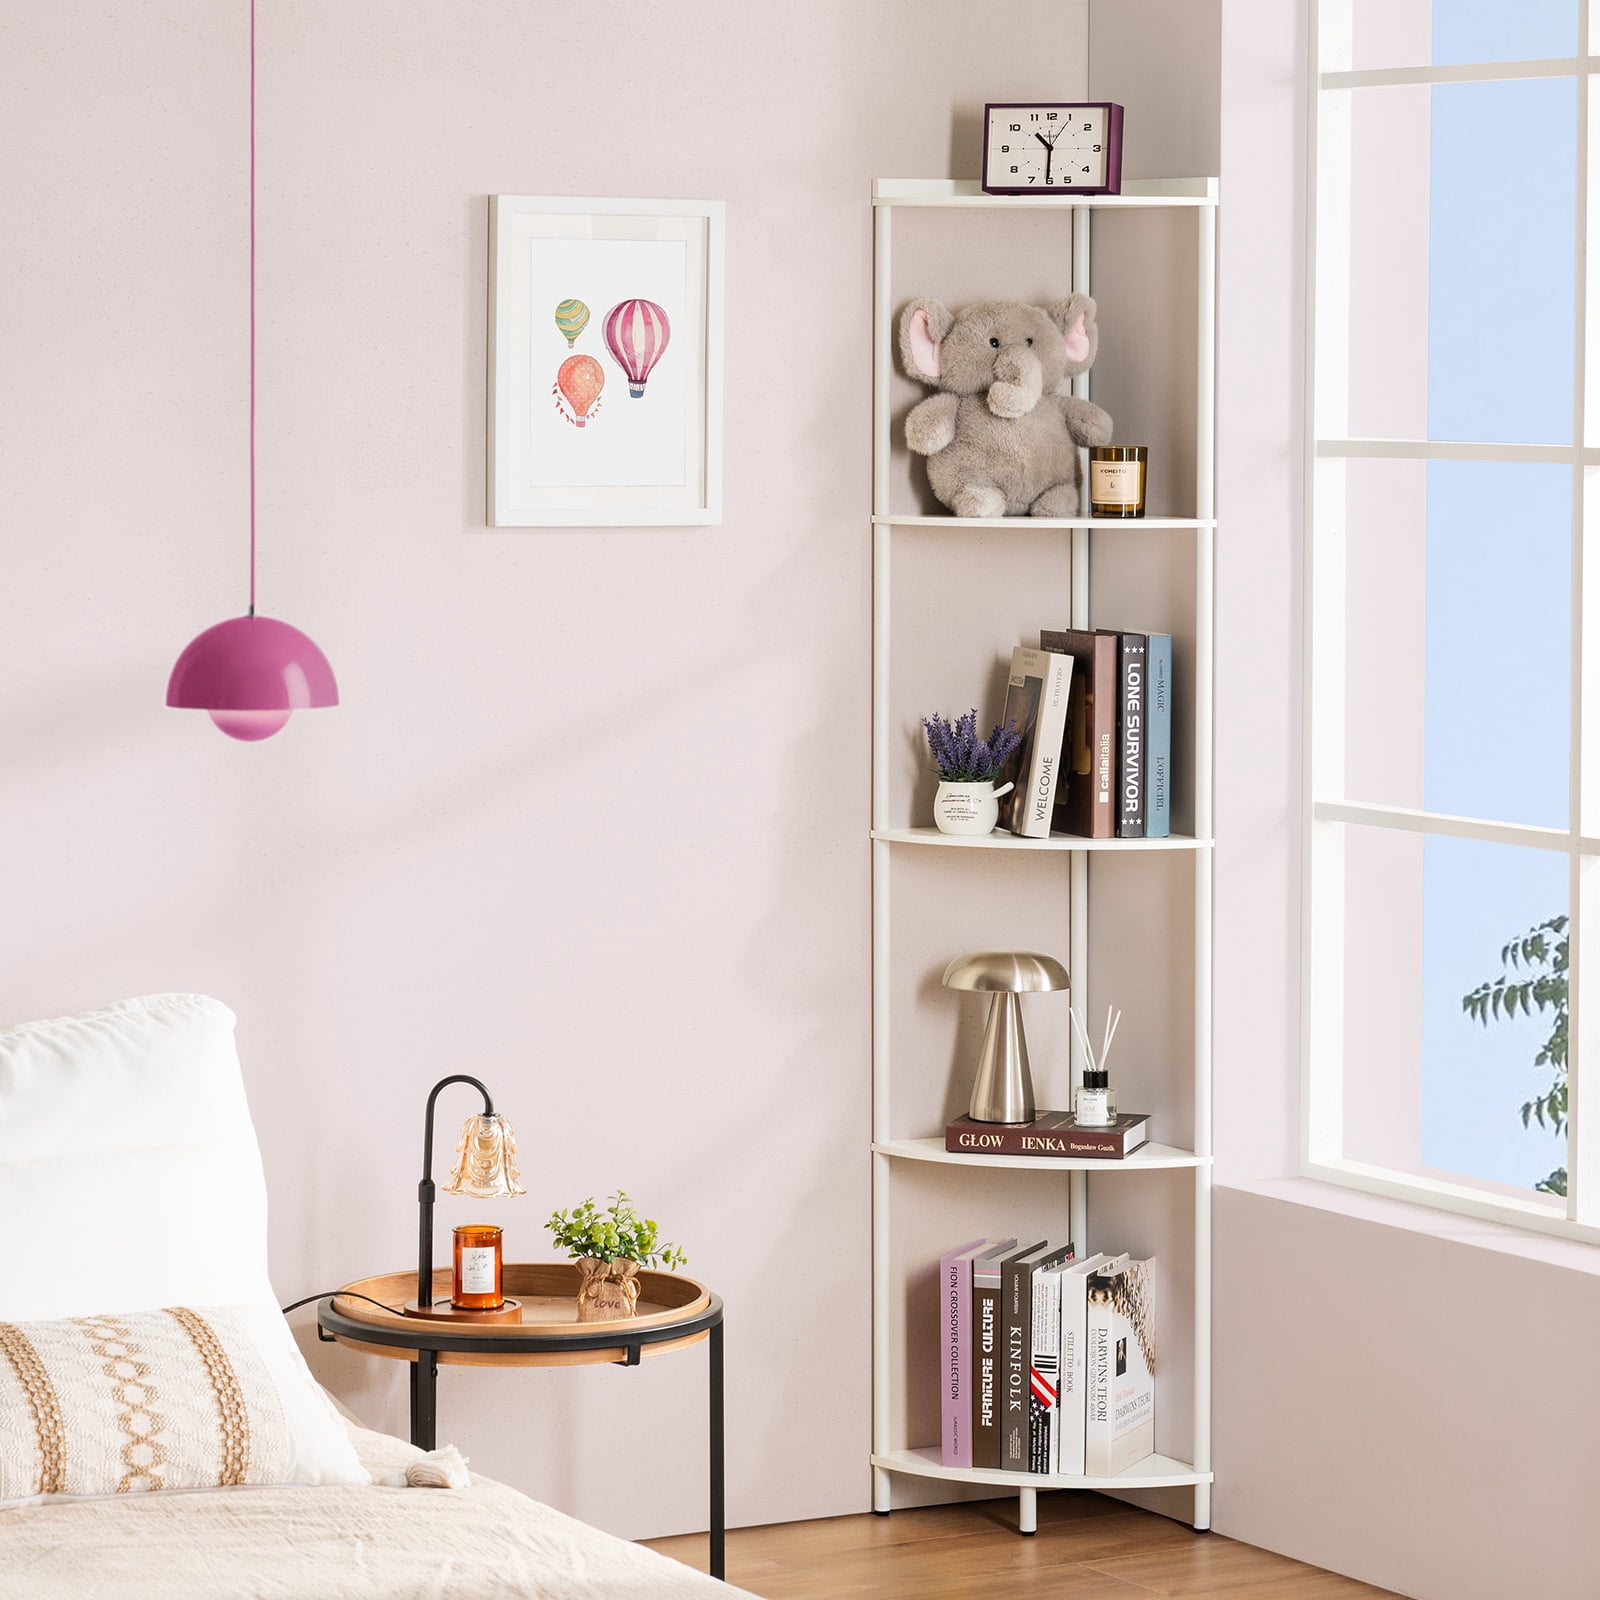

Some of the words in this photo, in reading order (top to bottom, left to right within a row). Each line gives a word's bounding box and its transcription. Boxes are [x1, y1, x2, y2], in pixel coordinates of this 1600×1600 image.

[1009, 124, 1021, 132] 10
[1046, 113, 1058, 121] 12
[1001, 145, 1010, 153] 9
[1028, 176, 1036, 184] 7
[1045, 177, 1054, 185] 6
[1063, 176, 1072, 184] 5
[1127, 663, 1140, 711] LONE
[1157, 680, 1165, 712] MAGIC
[1125, 715, 1140, 812] SURVIVOR
[1035, 757, 1053, 821] WELCOME
[1021, 1136, 1066, 1151] IENKA
[950, 1266, 958, 1288] FION
[593, 1298, 621, 1310] love
[950, 1290, 958, 1344] CROSSOVER
[982, 1298, 994, 1353] CULTURE
[1009, 1325, 1022, 1411] KINFOLK
[1098, 1328, 1108, 1385] DARWINS
[951, 1345, 959, 1400] COLLECTION
[1066, 1371, 1074, 1393] BOOK
[1097, 1385, 1107, 1422] TEORI
